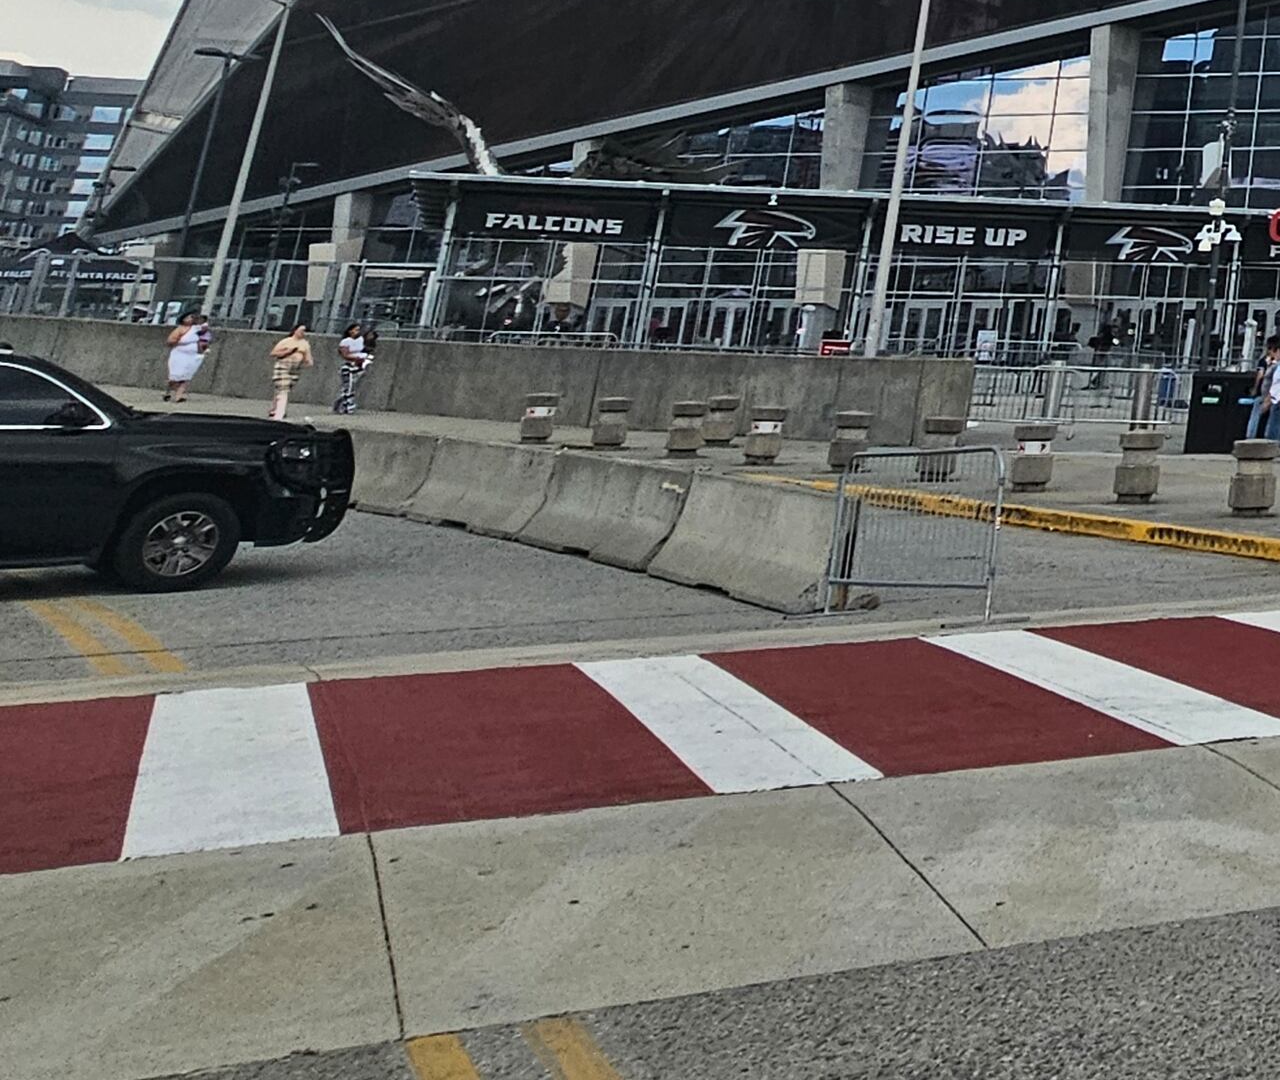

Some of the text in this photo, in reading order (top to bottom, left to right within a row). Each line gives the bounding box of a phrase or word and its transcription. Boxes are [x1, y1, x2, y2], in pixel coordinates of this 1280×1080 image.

[485, 212, 624, 235] FALCONS
[900, 224, 1028, 247] RISE UP
